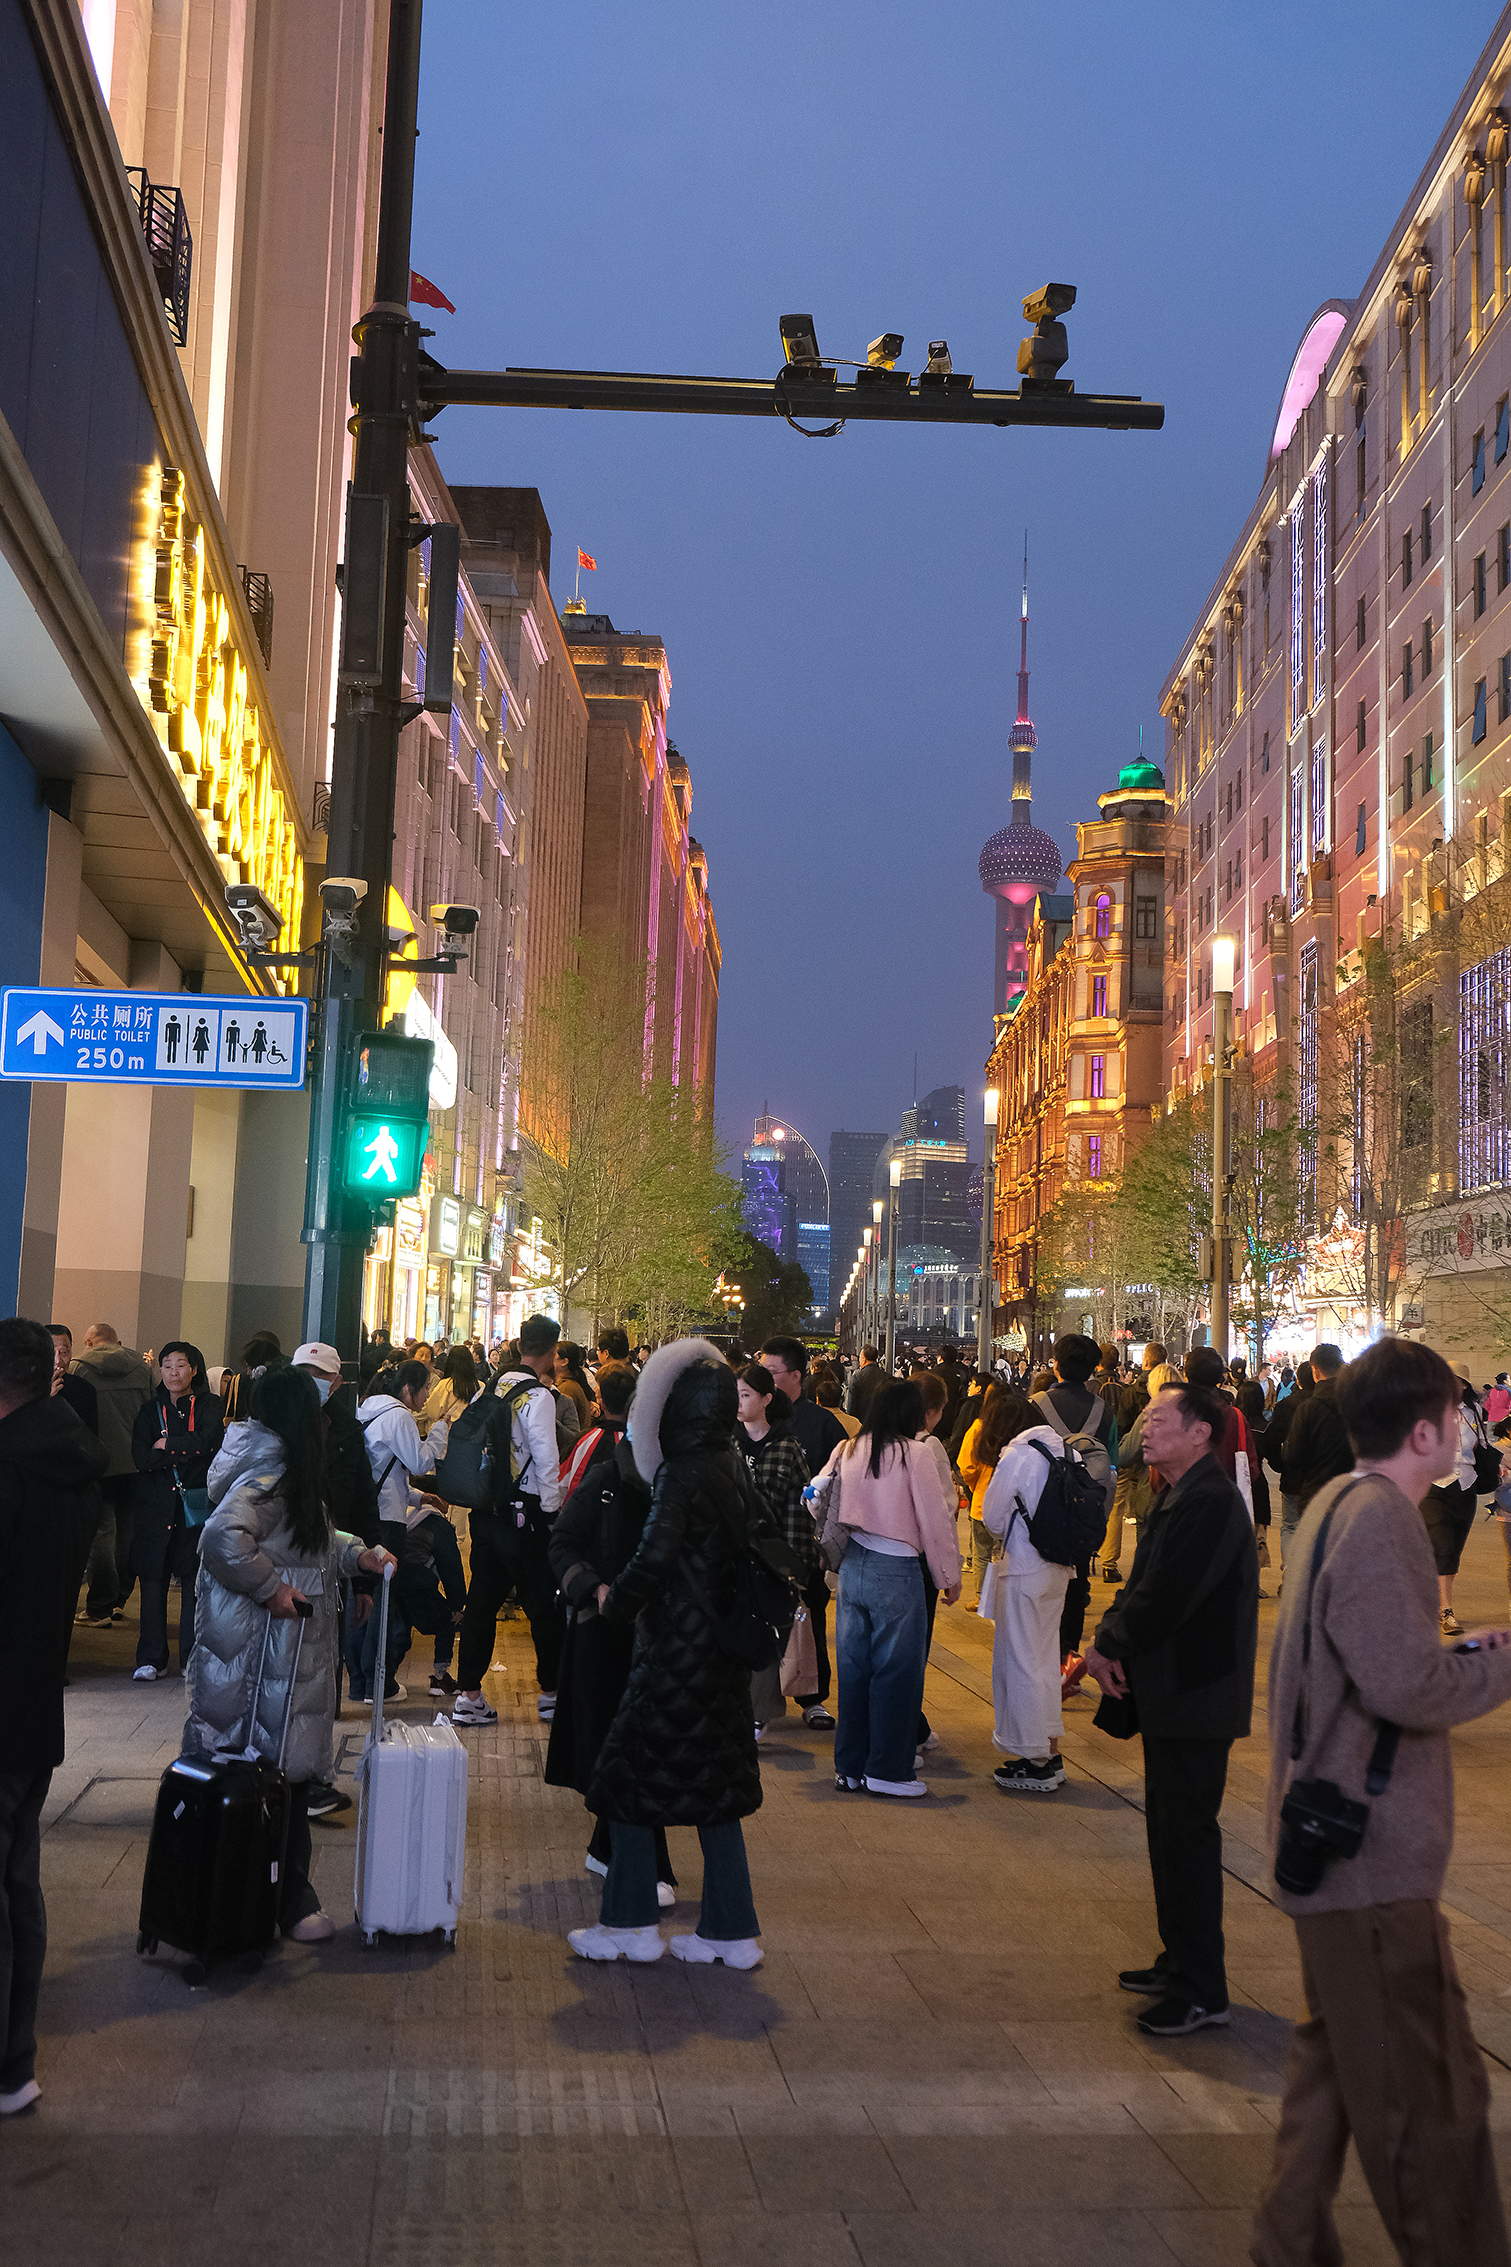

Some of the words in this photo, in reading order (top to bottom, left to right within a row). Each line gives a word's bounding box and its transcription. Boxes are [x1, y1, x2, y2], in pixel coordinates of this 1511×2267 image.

[70, 1003, 153, 1029] 公共厕所
[70, 1028, 107, 1040] PUBLIC
[115, 1030, 150, 1042] TOILET
